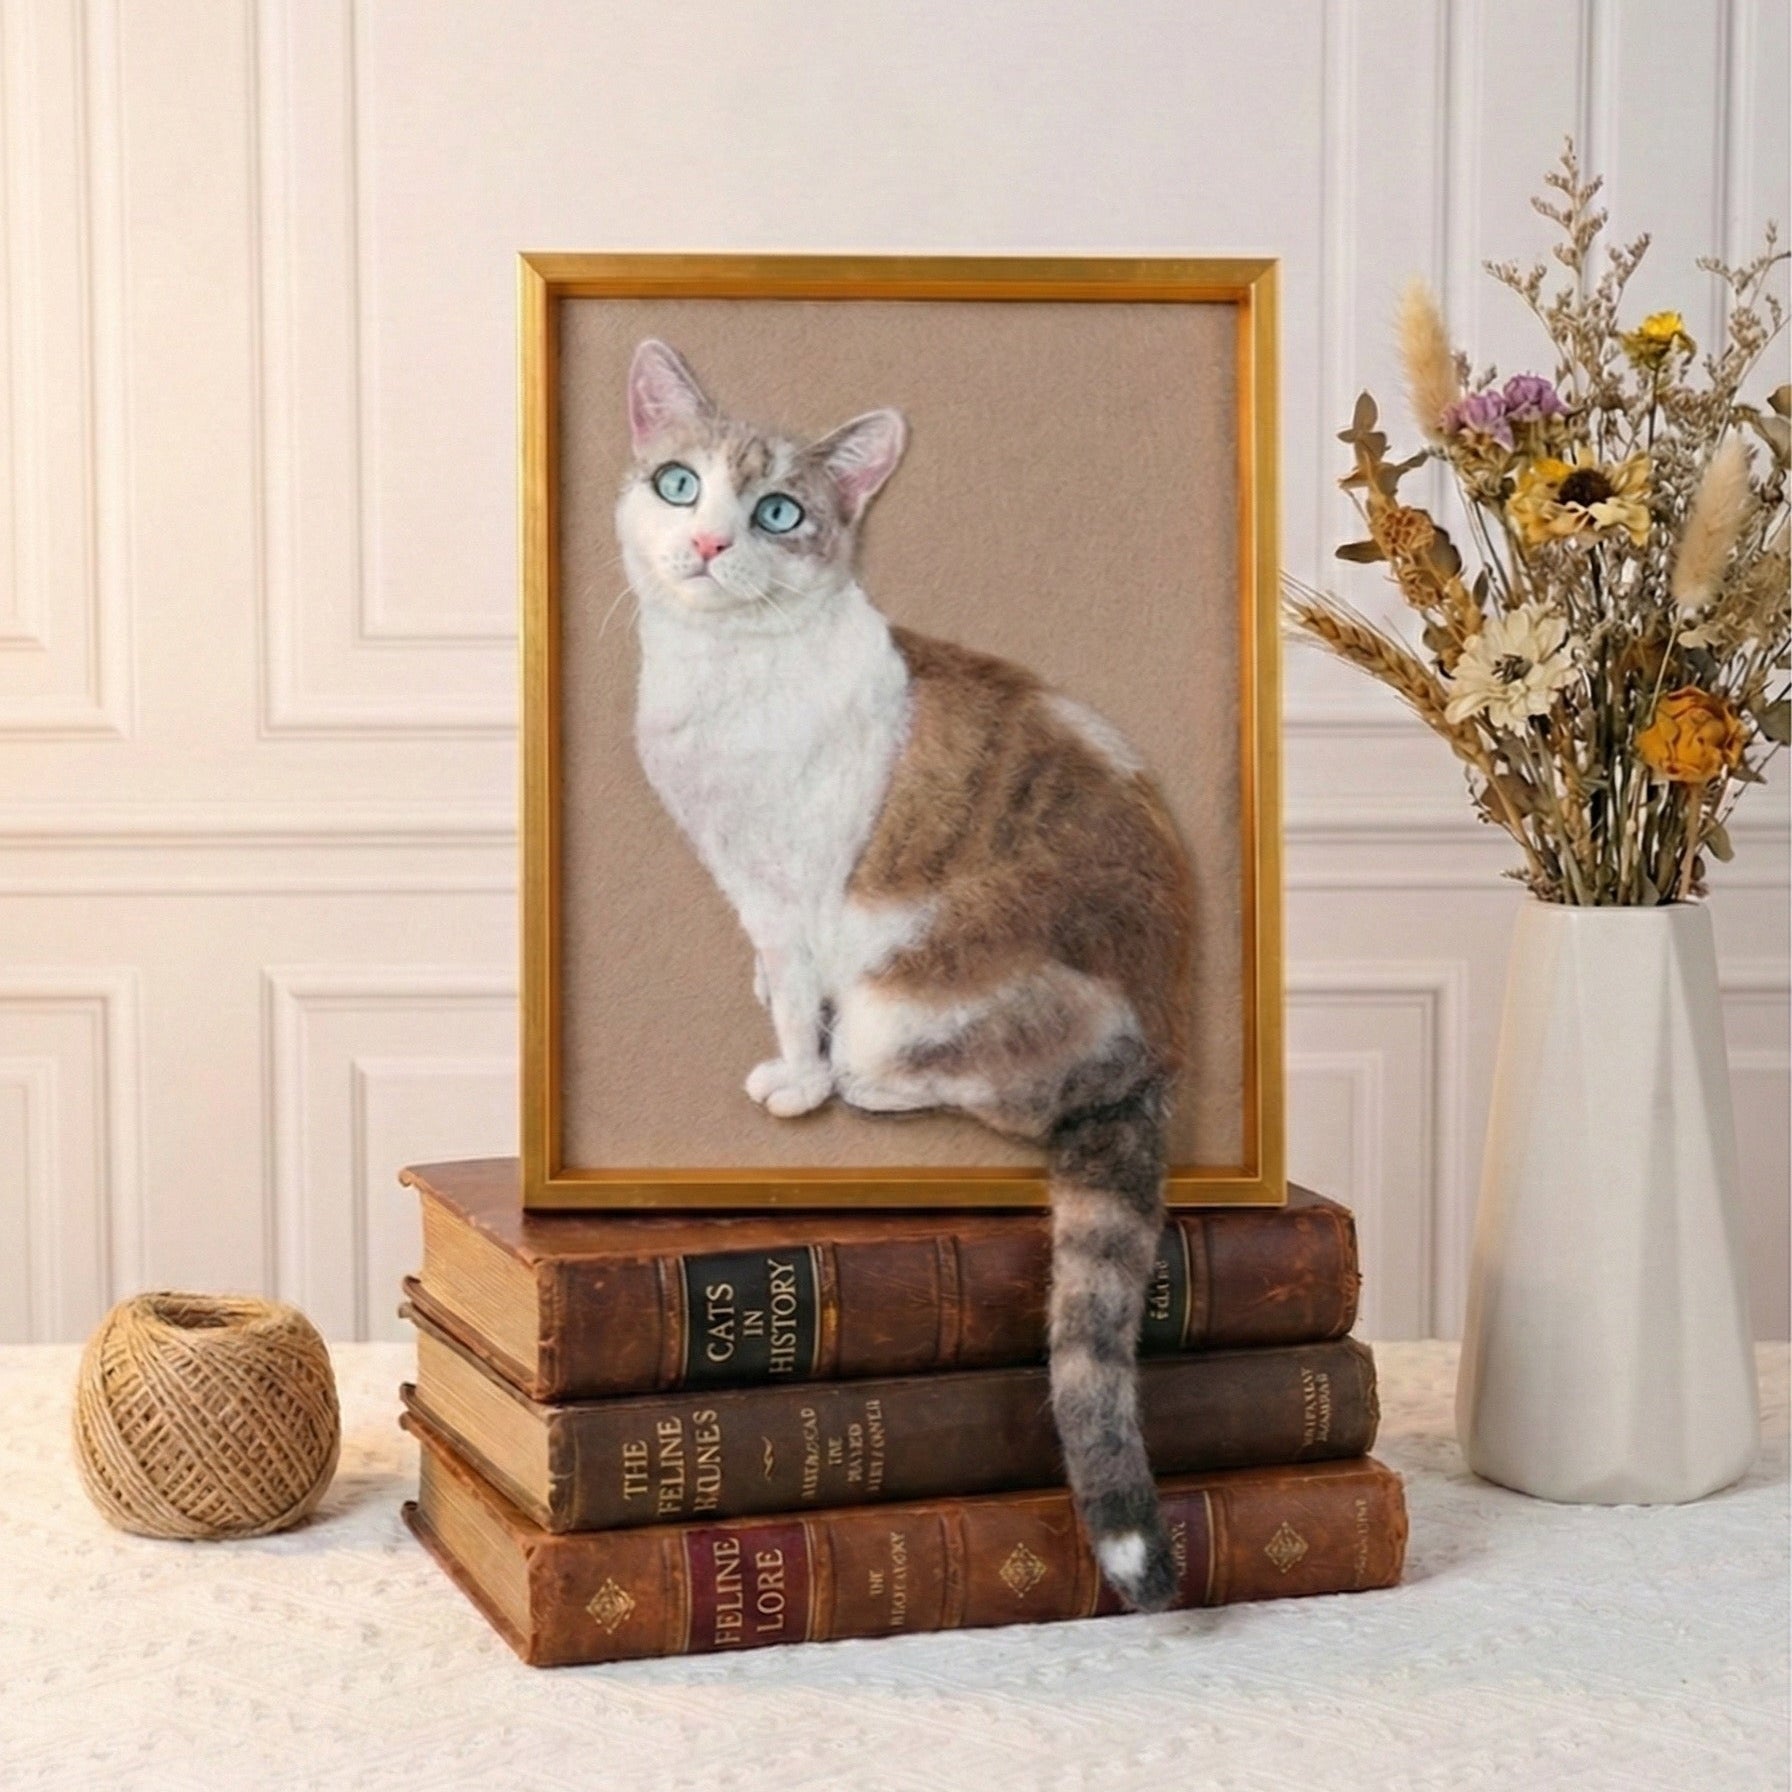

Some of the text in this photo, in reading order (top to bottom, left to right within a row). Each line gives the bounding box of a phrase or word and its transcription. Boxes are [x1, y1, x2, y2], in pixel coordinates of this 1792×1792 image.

[706, 1283, 735, 1362] CATS
[743, 1310, 764, 1337] IN
[767, 1258, 797, 1373] HISTORY
[623, 1439, 648, 1500] THE
[657, 1416, 686, 1516] FELINE
[713, 1536, 743, 1646] FELINE
[755, 1548, 785, 1633] LORE
